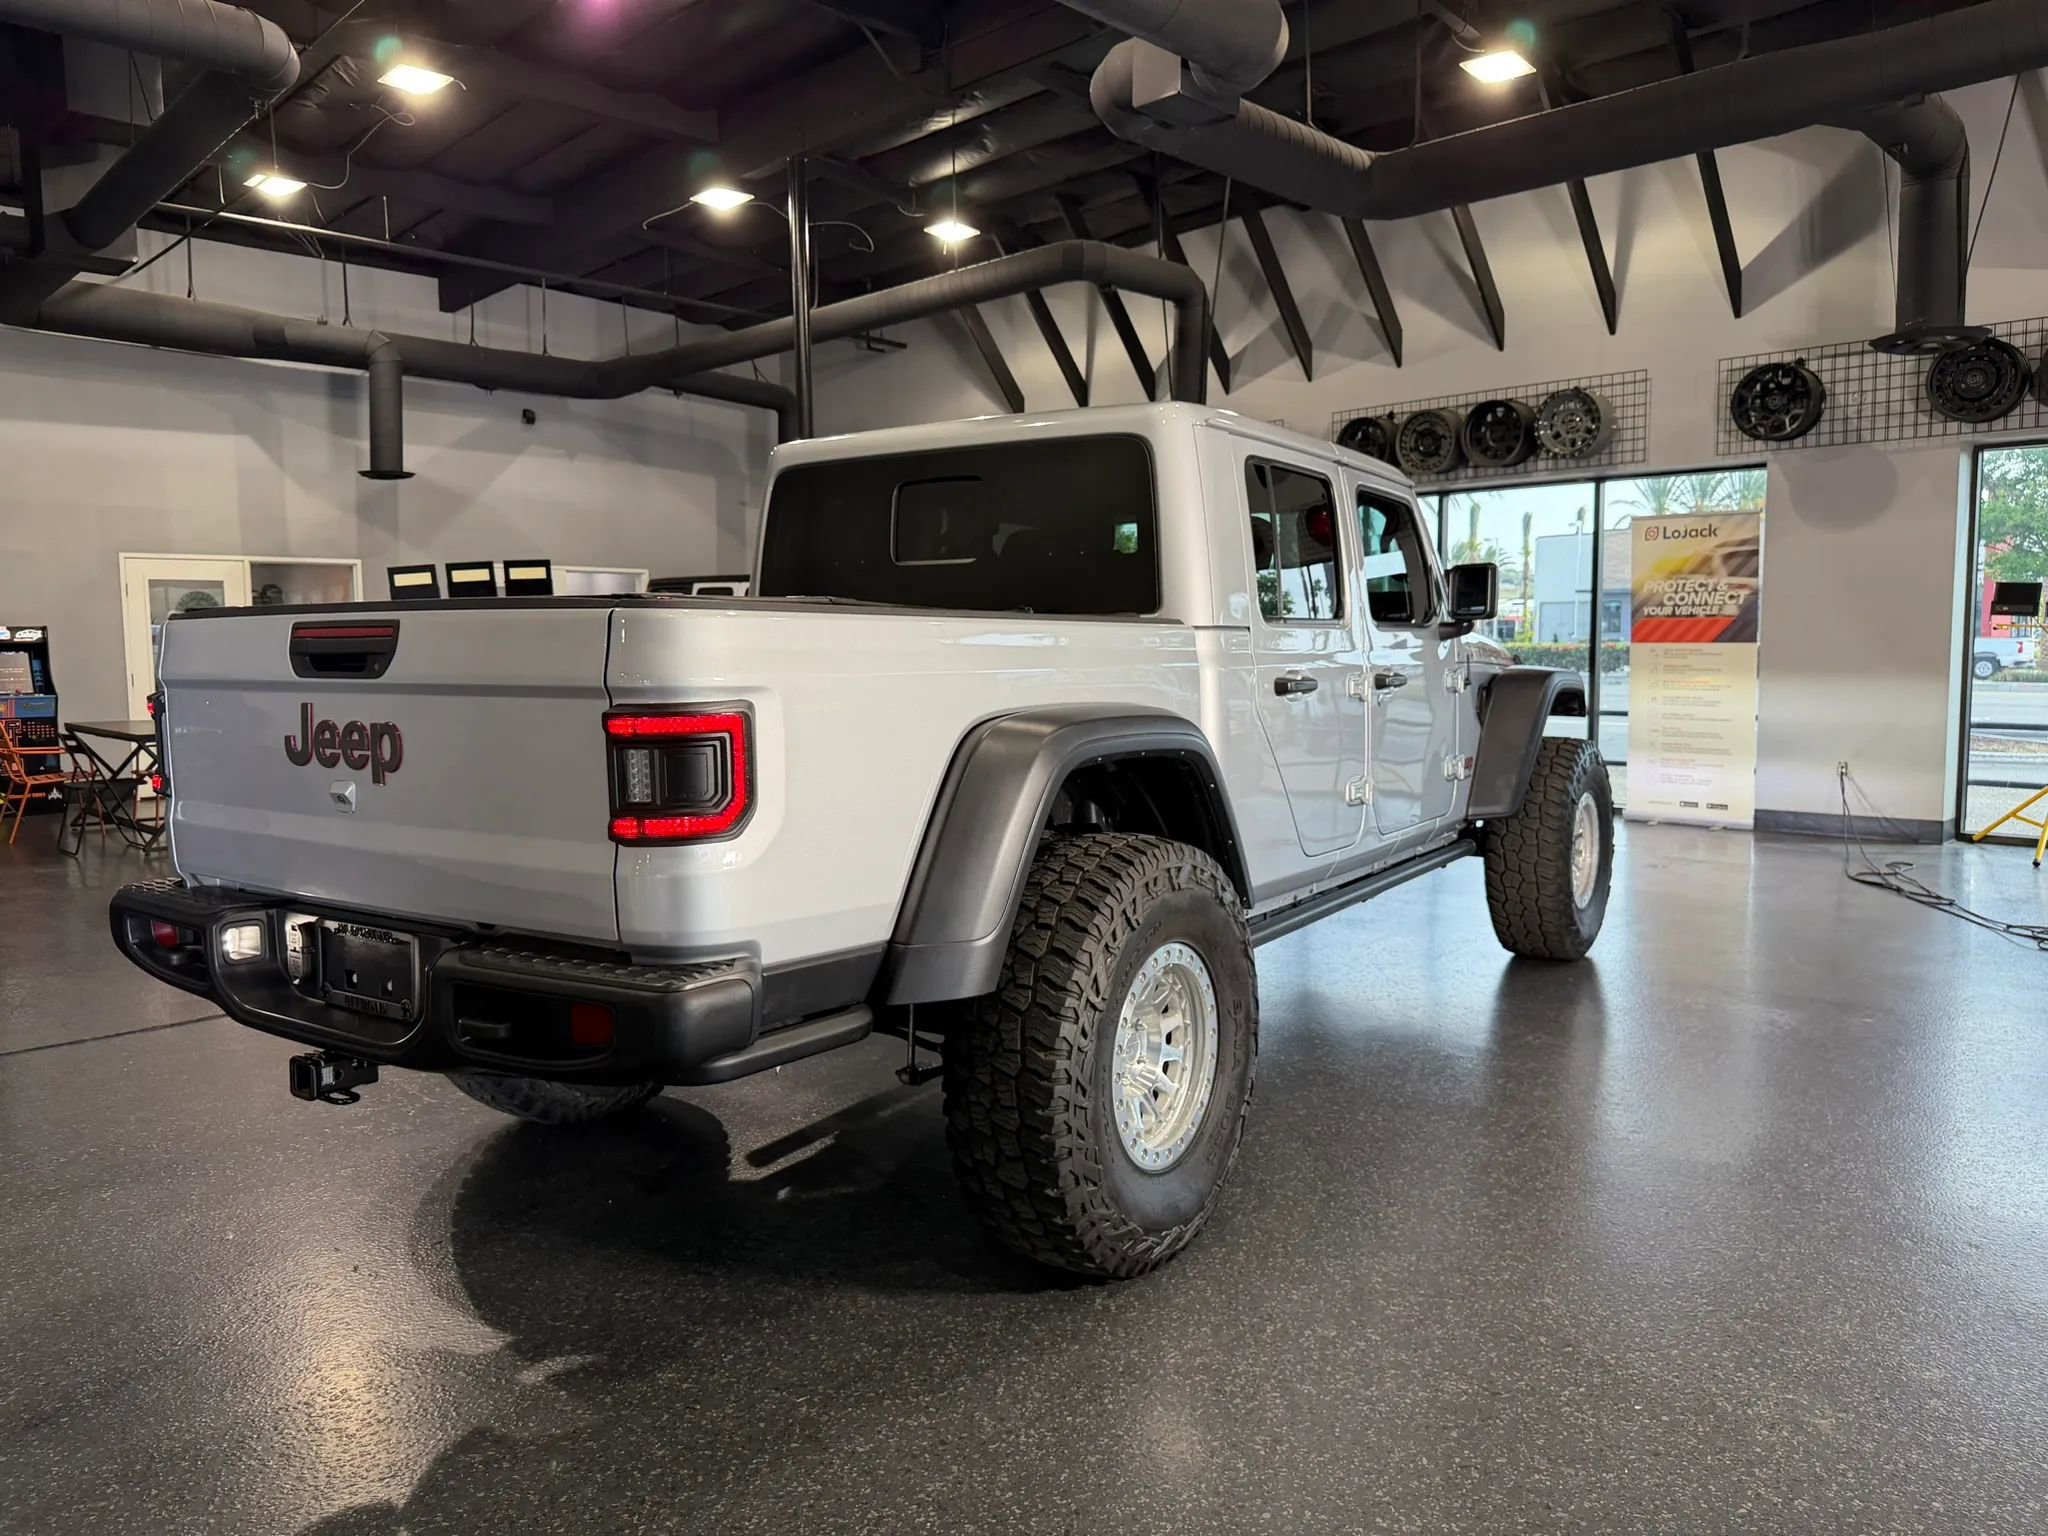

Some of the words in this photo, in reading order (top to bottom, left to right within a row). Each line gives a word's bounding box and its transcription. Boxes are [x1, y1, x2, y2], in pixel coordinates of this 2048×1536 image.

[1642, 579, 1716, 593] PROTECT
[1716, 579, 1728, 592] &
[1662, 590, 1751, 606] CONNECT
[1642, 605, 1674, 616] YOUR
[1674, 604, 1720, 616] VEHICLE
[284, 702, 403, 787] Jeep
